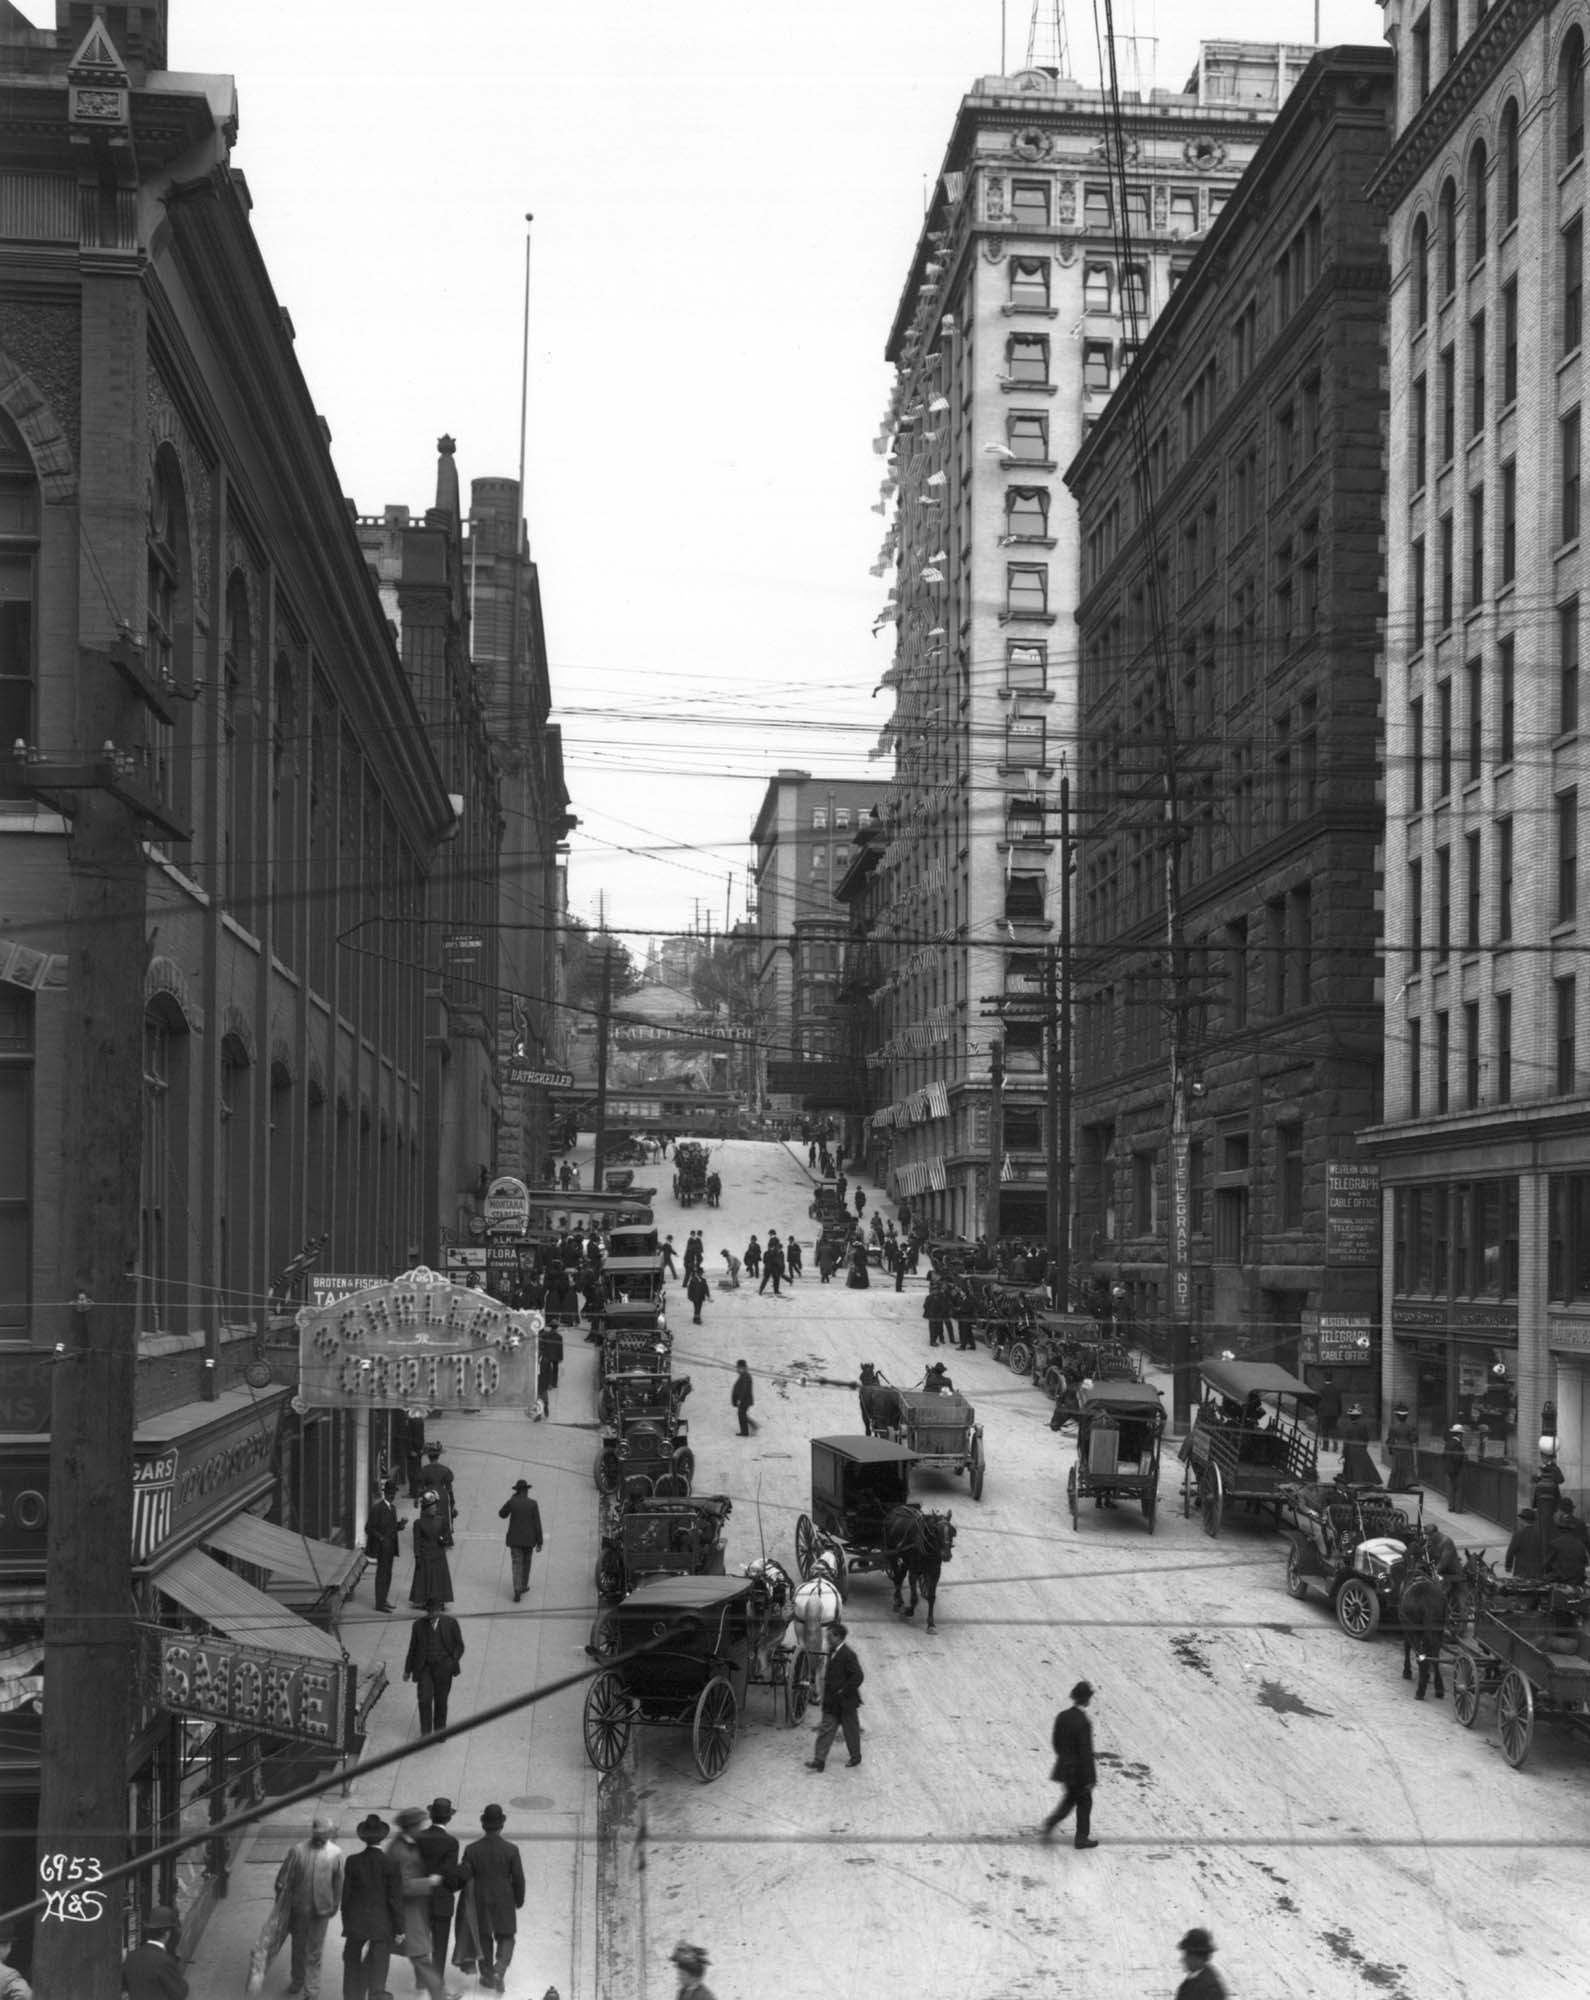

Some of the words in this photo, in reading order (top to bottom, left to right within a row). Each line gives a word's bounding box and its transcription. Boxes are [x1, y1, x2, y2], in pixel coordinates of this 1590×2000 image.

[511, 1069, 573, 1088] RATHSKELLER
[1329, 1177, 1380, 1191] TELEGRAPH
[489, 1199, 523, 1209] MONTANA
[1176, 1156, 1188, 1262] TELEGRAPH
[1329, 1197, 1353, 1208] CABLE
[1353, 1197, 1378, 1208] OFFICE
[1320, 1349, 1344, 1361] CABLE
[1344, 1350, 1369, 1361] OFFICE
[339, 1353, 500, 1397] GROTTO
[166, 1645, 330, 1737] SMOKE
